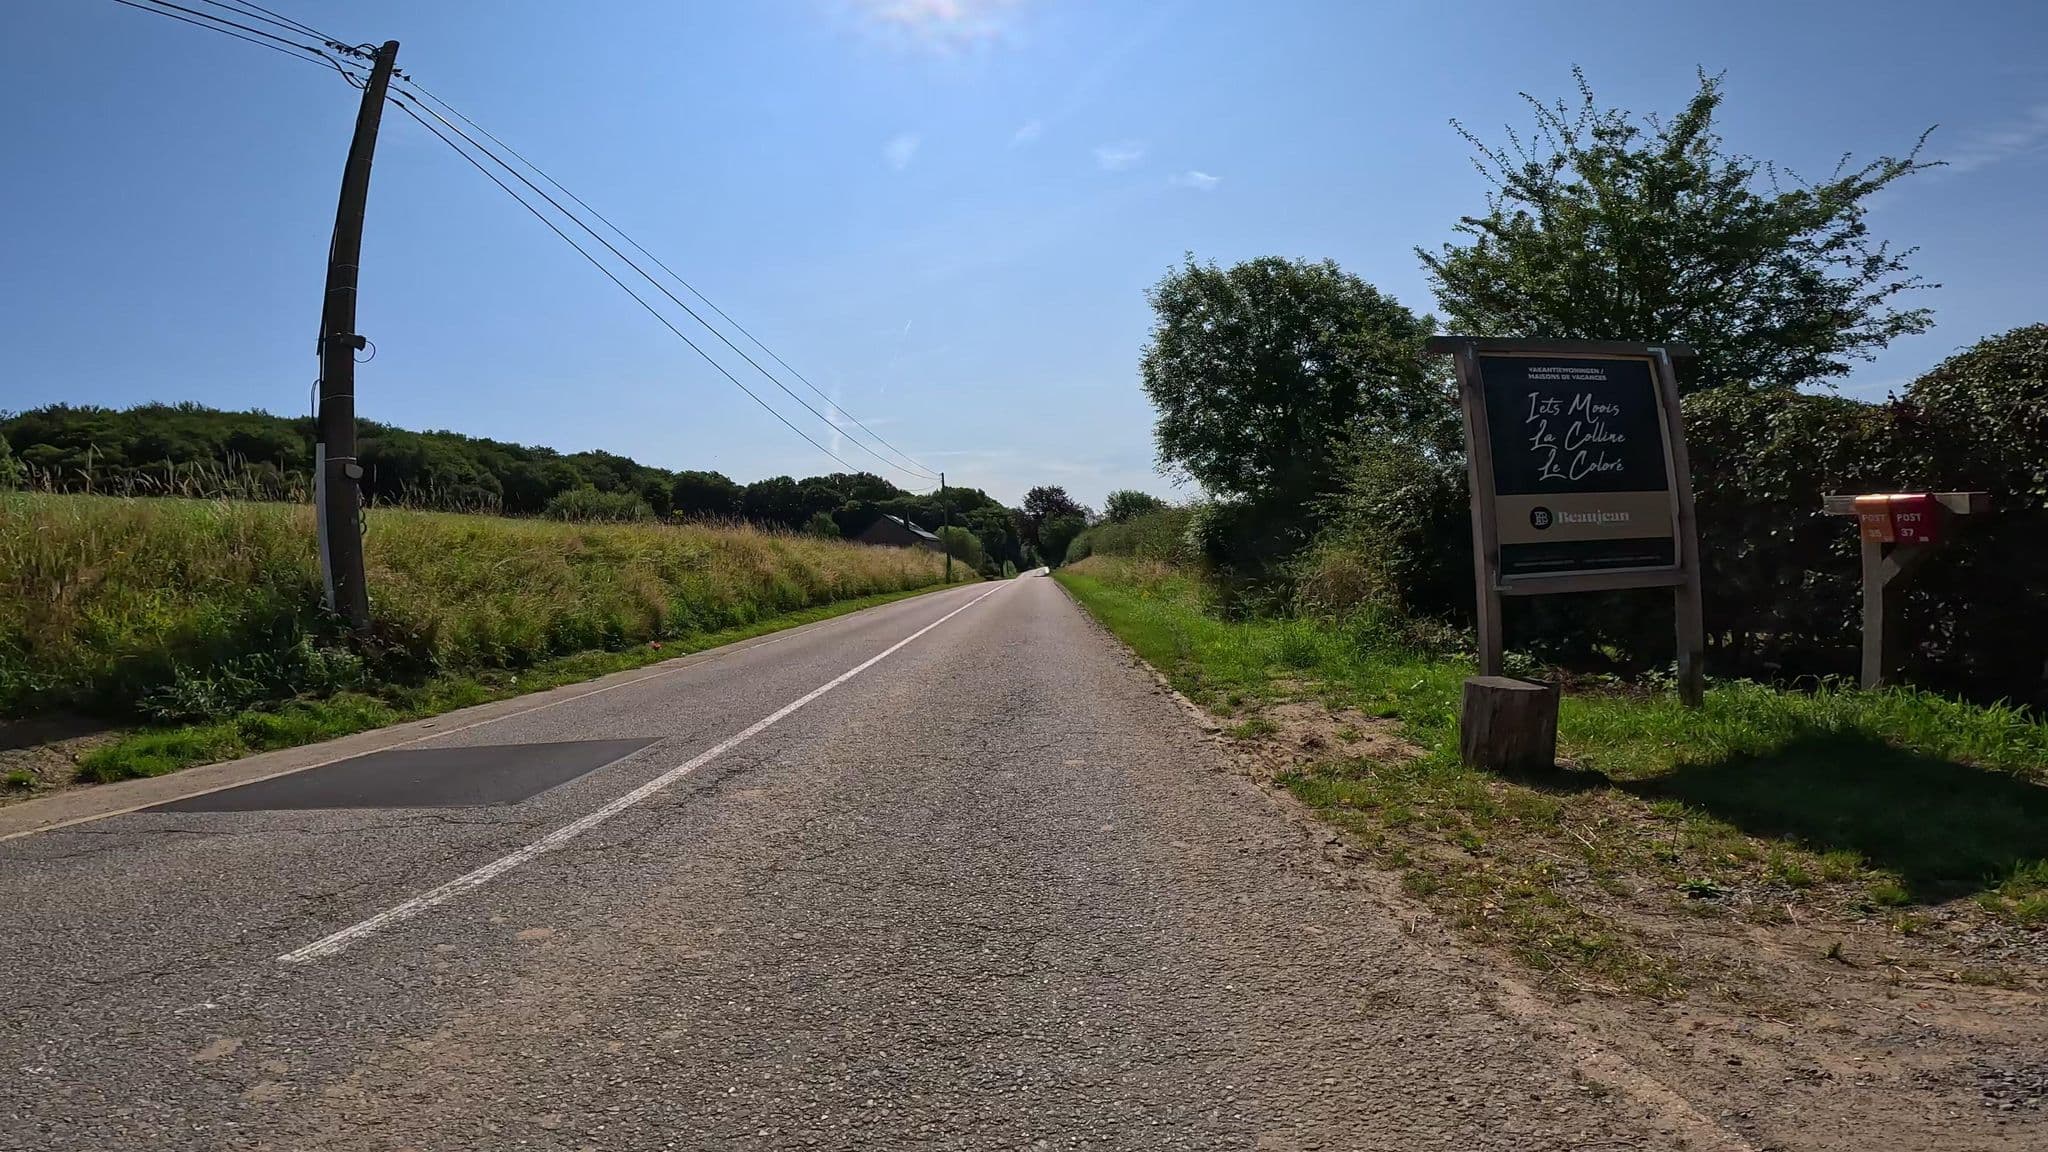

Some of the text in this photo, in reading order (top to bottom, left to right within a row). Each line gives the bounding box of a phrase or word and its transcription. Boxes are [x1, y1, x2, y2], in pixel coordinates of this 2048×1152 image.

[1526, 392, 1620, 423] Iets Moois
[1529, 420, 1625, 451] La Colline
[1537, 449, 1624, 481] Le Coloré
[1558, 510, 1630, 524] Beaujean
[1862, 514, 1886, 522] POST
[1896, 513, 1921, 522] POST
[1901, 528, 1914, 537] 37
